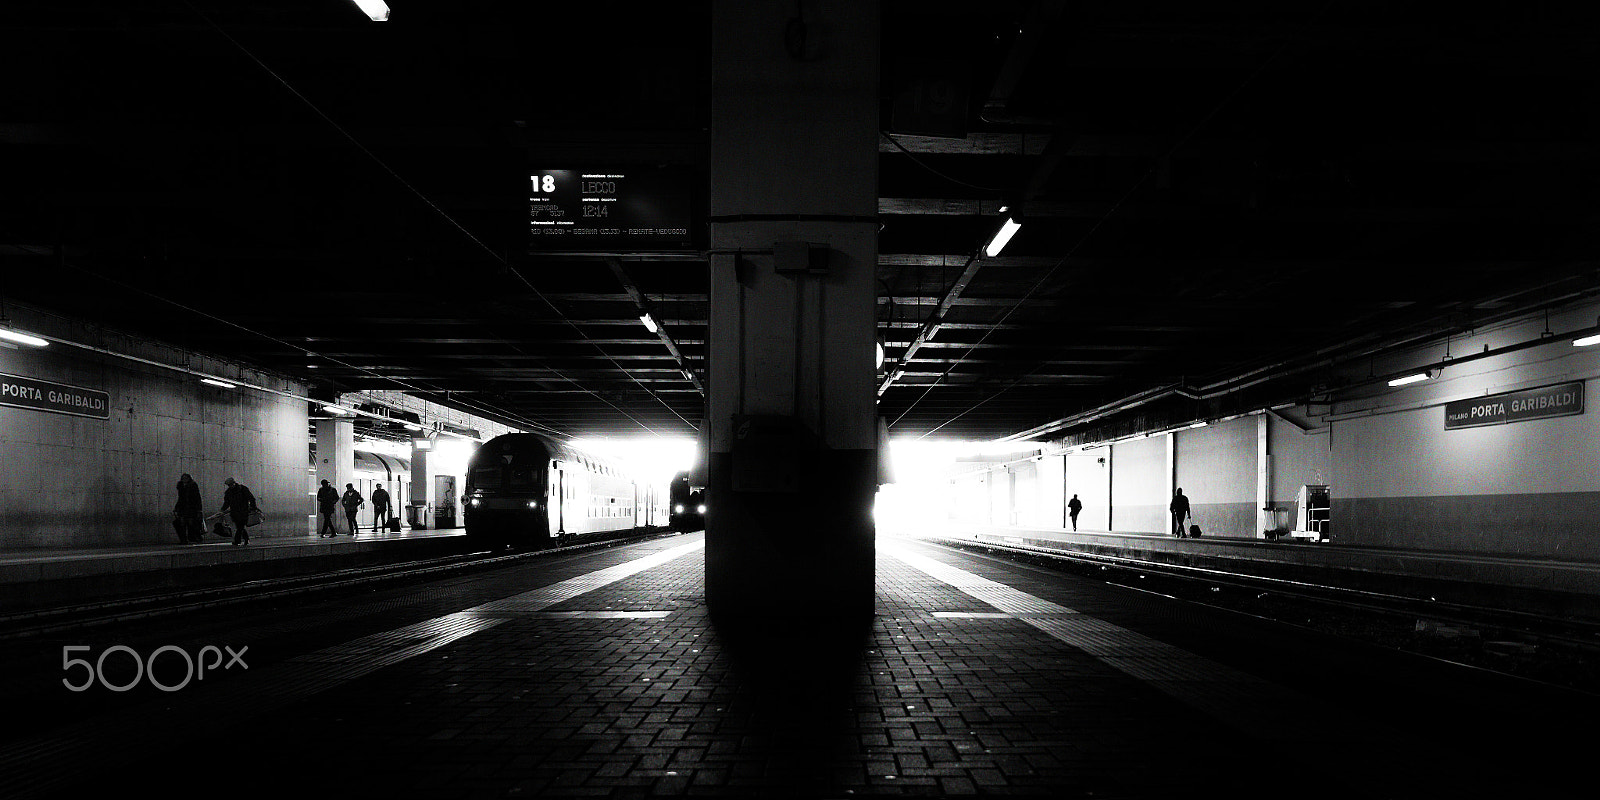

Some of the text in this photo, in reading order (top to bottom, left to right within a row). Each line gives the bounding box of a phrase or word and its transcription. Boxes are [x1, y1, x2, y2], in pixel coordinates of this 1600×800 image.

[530, 175, 556, 193] 18
[581, 181, 616, 194] LECCO
[582, 204, 609, 218] 12:14
[2, 383, 105, 411] PORTA GARIBALDI
[1448, 392, 1576, 421] MILANO PORTA GARIBALDI
